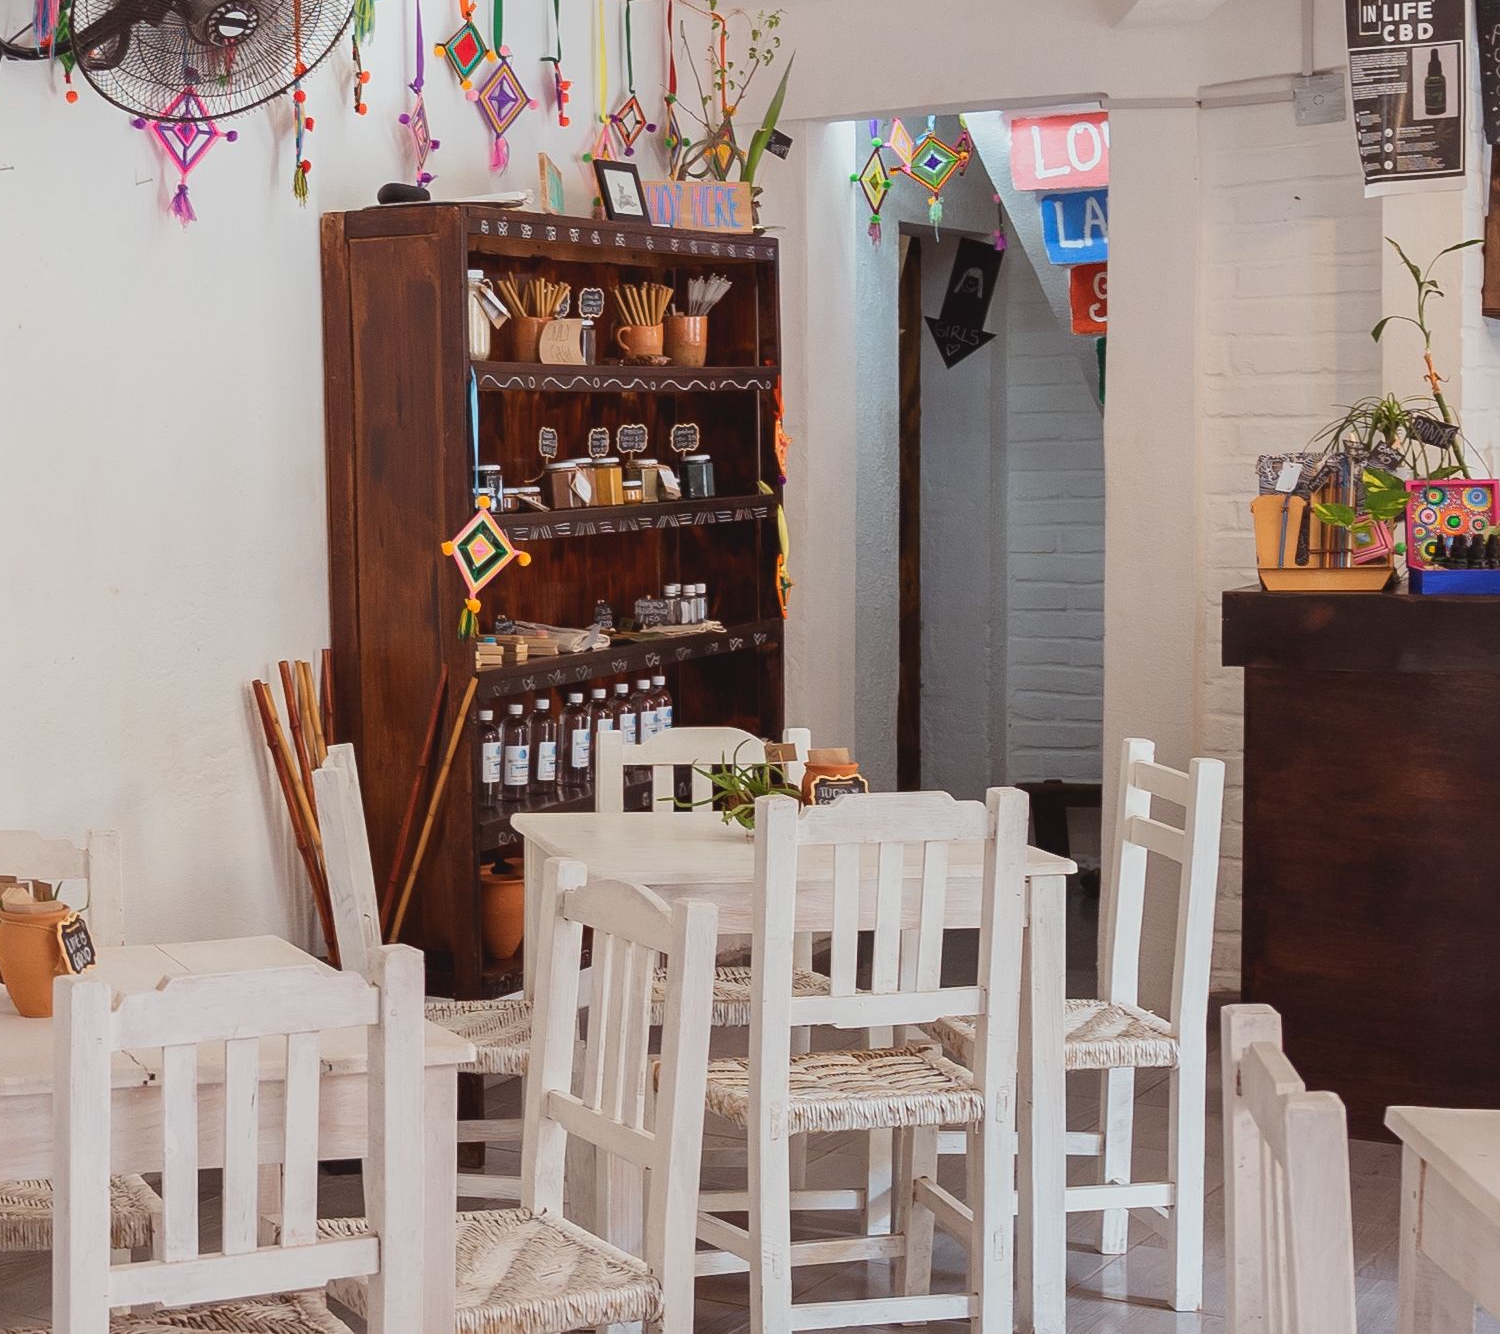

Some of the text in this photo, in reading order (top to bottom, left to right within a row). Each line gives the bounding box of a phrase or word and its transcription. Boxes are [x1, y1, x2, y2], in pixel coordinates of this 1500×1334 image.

[1363, 1, 1434, 23] IN LIFE
[1383, 22, 1434, 42] CBD
[1031, 121, 1110, 180] LO
[935, 322, 980, 346] GIRLS
